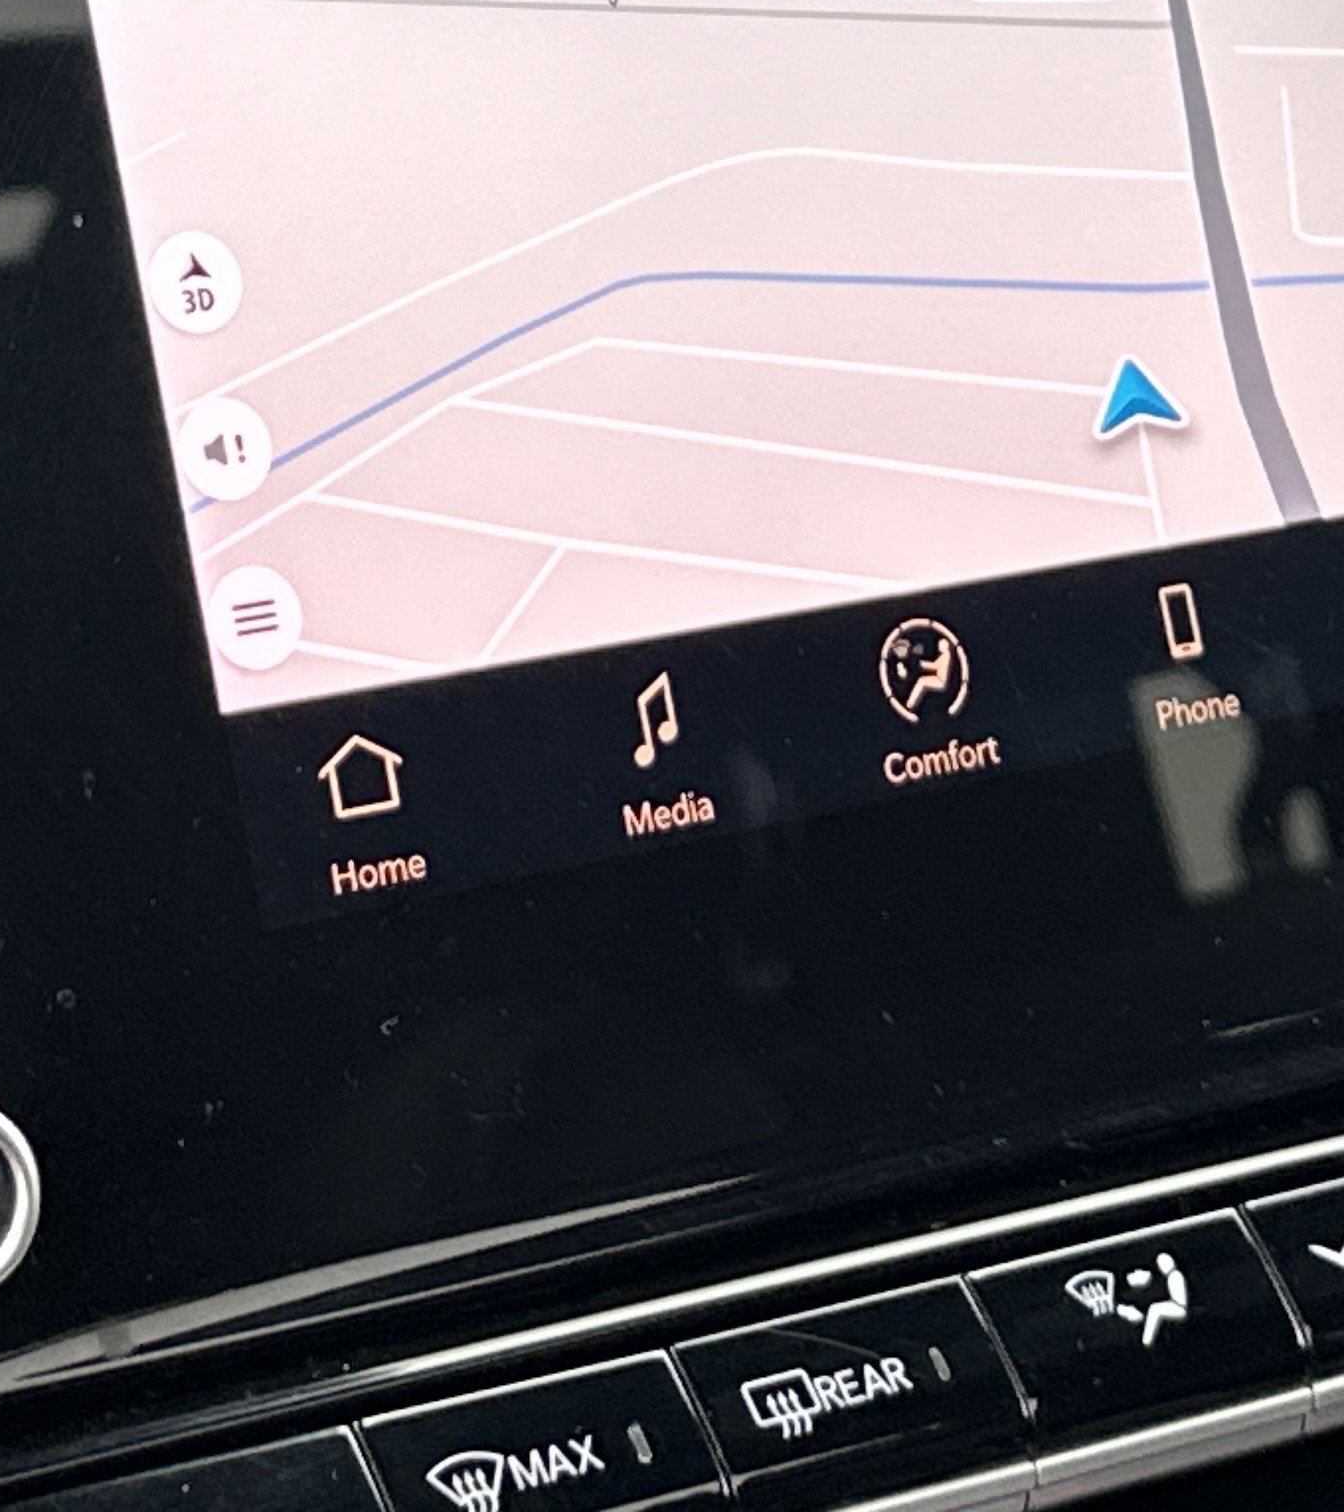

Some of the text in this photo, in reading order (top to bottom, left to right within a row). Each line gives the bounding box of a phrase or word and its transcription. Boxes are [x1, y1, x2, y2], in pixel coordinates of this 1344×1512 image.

[181, 288, 214, 314] 3D
[1156, 688, 1240, 731] Phone
[883, 735, 1002, 784] Comfort
[622, 789, 716, 838] Media
[330, 849, 427, 895] Home
[813, 1356, 915, 1414] REAR
[507, 1433, 606, 1492] MAX
